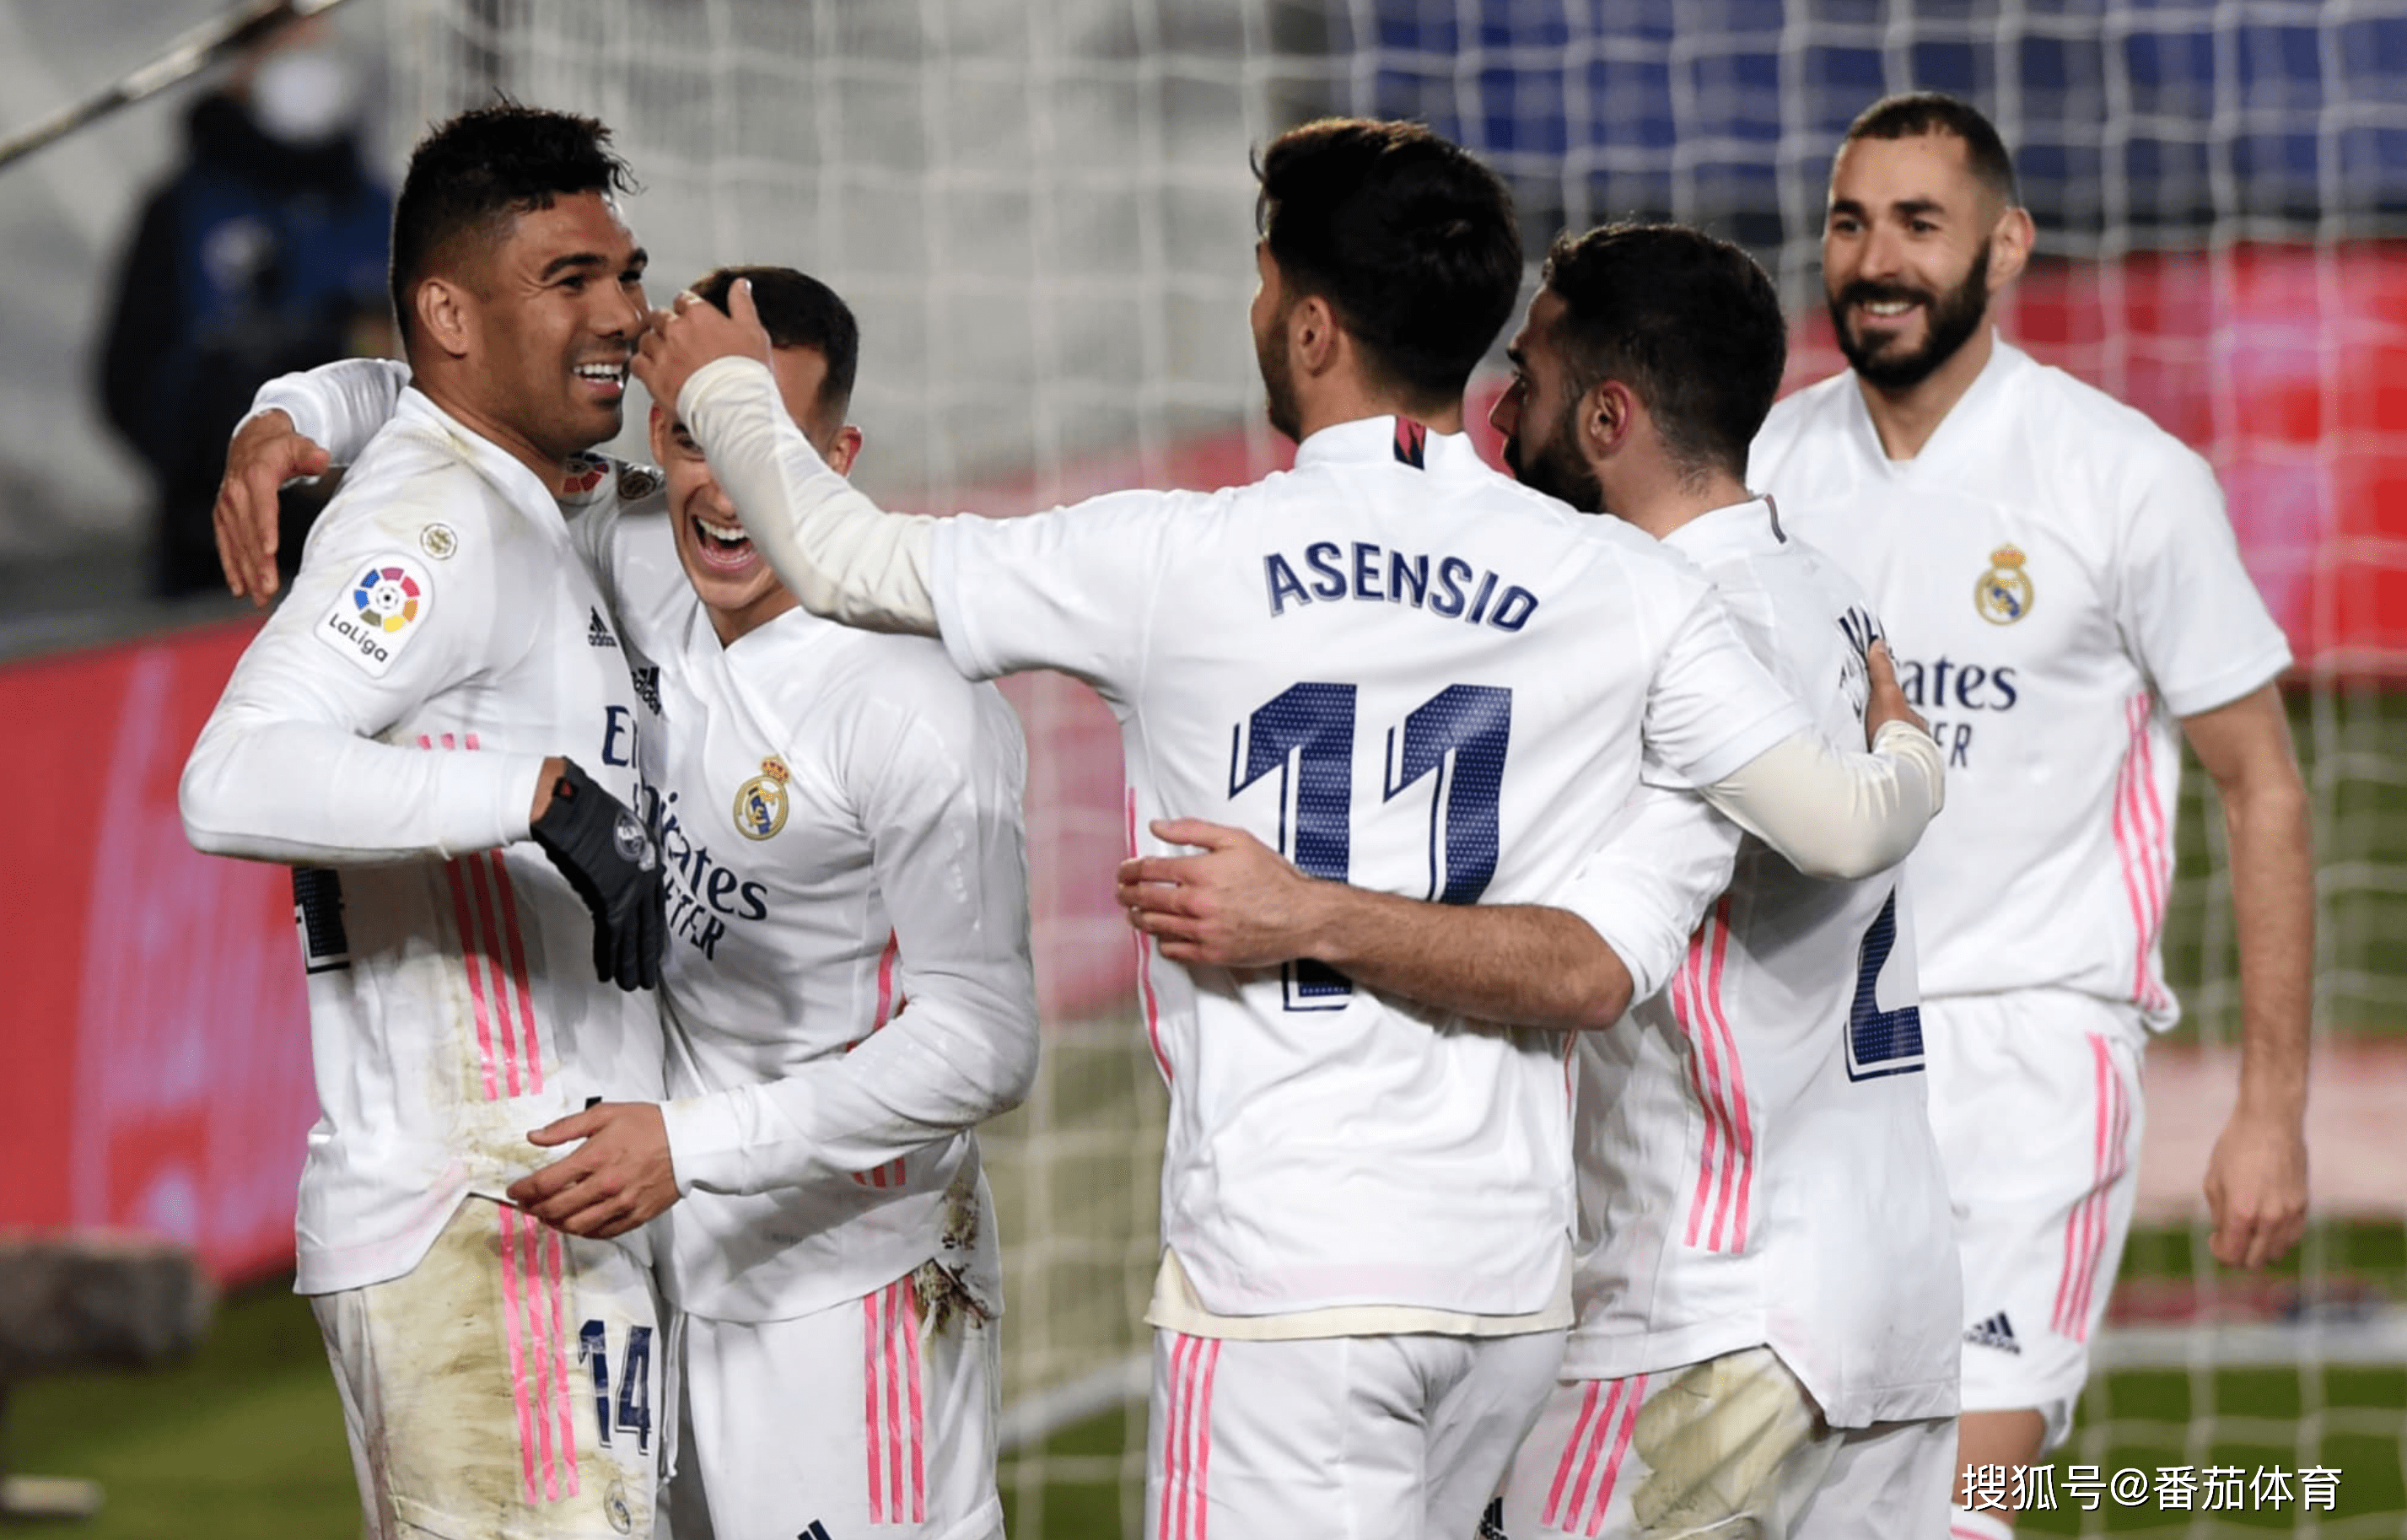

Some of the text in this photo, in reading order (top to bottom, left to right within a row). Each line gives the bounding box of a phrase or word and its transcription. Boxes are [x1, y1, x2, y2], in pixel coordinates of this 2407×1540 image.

[1263, 541, 1539, 633] ASENSIO
[329, 612, 390, 663] LaLiga
[1897, 654, 2017, 712] ates
[1228, 681, 1513, 1011] 11
[578, 1318, 654, 1457] 14
